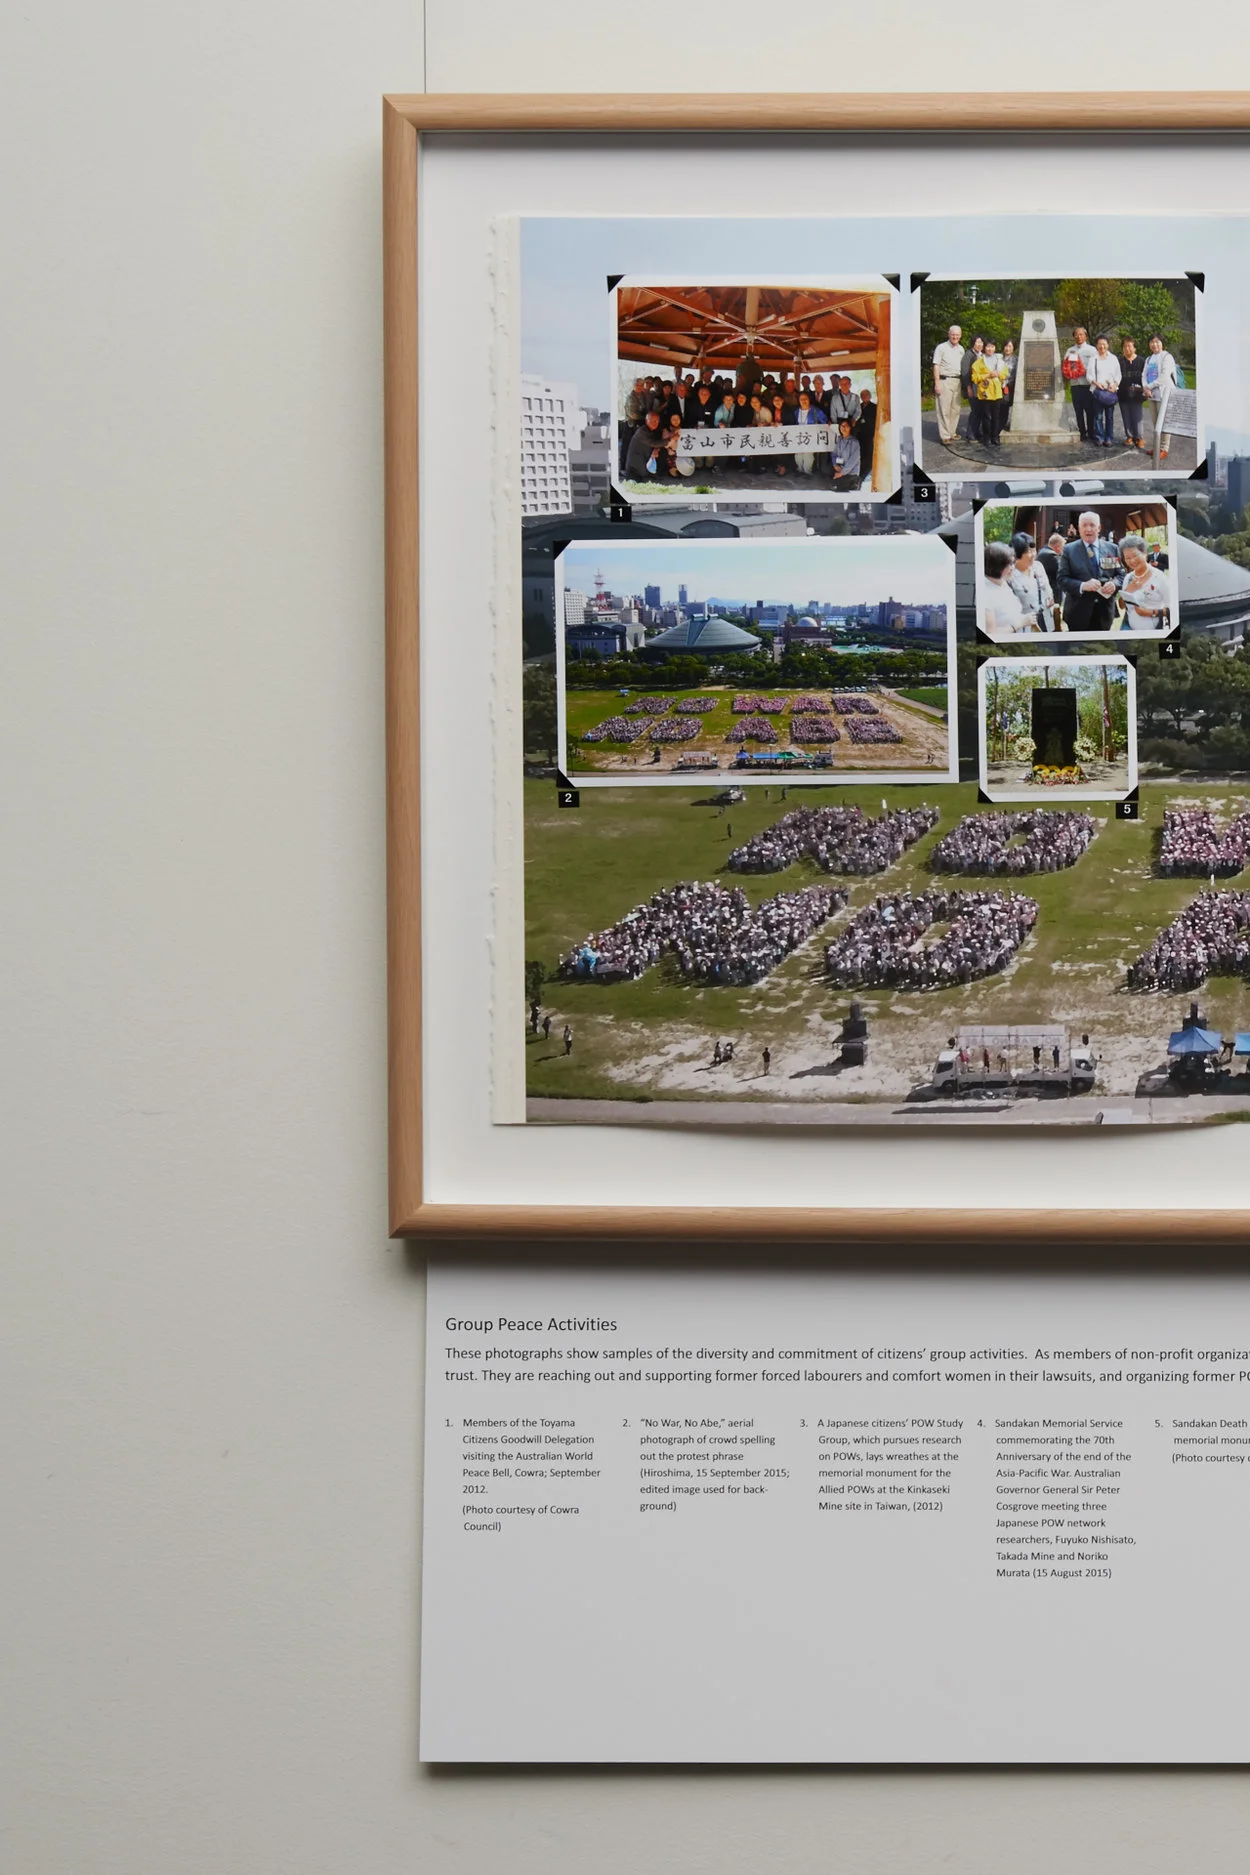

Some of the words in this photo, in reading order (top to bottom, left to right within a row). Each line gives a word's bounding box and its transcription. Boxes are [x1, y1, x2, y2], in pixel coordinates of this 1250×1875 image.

[921, 487, 929, 498] 3
[617, 507, 624, 517] 1
[1165, 643, 1174, 654] 4
[564, 792, 572, 803] 2
[1123, 804, 1131, 814] 5
[445, 1317, 494, 1334] Group
[498, 1317, 543, 1331] Peace
[546, 1317, 618, 1332] Activities
[444, 1346, 482, 1360] These
[485, 1346, 564, 1362] photographs
[566, 1347, 600, 1360] show
[602, 1347, 653, 1362] samples
[655, 1346, 670, 1360] of
[671, 1347, 693, 1360] the
[695, 1347, 749, 1362] diversity
[751, 1347, 775, 1360] and
[778, 1347, 858, 1360] commitment
[860, 1347, 875, 1360] of
[929, 1350, 967, 1363] group
[969, 1348, 1028, 1360] activities.
[1034, 1348, 1050, 1360] As
[1053, 1347, 1112, 1360] members
[1114, 1347, 1128, 1360] of
[1130, 1347, 1194, 1363] non-profit
[444, 1370, 478, 1381] trust.
[480, 1368, 512, 1384] They
[514, 1372, 535, 1382] are
[538, 1369, 591, 1384] reaching
[593, 1370, 616, 1382] out
[618, 1369, 642, 1382] and
[644, 1369, 713, 1384] supporting
[715, 1369, 759, 1382] former
[761, 1369, 801, 1382] forced
[803, 1369, 863, 1382] labourers
[865, 1369, 889, 1382] and
[892, 1369, 942, 1382] comfort
[944, 1372, 992, 1382] women
[994, 1370, 1006, 1382] in
[1009, 1369, 1040, 1382] their
[1042, 1369, 1096, 1384] lawsuits,
[1099, 1369, 1123, 1382] and
[1125, 1370, 1190, 1385] organizing
[1192, 1369, 1236, 1382] former
[445, 1418, 454, 1428] 1.
[462, 1417, 508, 1428] Members
[509, 1417, 521, 1428] of
[521, 1418, 538, 1428] the
[539, 1418, 576, 1430] Toyama
[622, 1418, 631, 1428] 2.
[660, 1418, 682, 1429] War,
[684, 1418, 699, 1428] No
[727, 1418, 754, 1428] aerial
[799, 1418, 809, 1428] 3.
[817, 1418, 825, 1428] A
[826, 1419, 870, 1430] Japanese
[911, 1418, 935, 1428] POW
[936, 1418, 964, 1430] Study
[976, 1418, 986, 1428] 4.
[994, 1418, 1040, 1428] Sandakan
[1042, 1418, 1088, 1428] Memorial
[1089, 1418, 1124, 1428] Service
[1154, 1419, 1164, 1428] 5.
[1172, 1418, 1218, 1428] Sandakan
[1219, 1418, 1248, 1429] Death
[462, 1484, 489, 1495] 2012.
[639, 1501, 677, 1513] ground)
[818, 1501, 843, 1511] Mine
[844, 1501, 862, 1511] site
[863, 1501, 873, 1511] in
[875, 1501, 911, 1512] Taiwan,
[912, 1501, 944, 1513] (2012)
[996, 1568, 1031, 1578] Murata
[1032, 1567, 1048, 1579] (15
[1050, 1568, 1083, 1580] August
[1085, 1568, 1112, 1580] 2015)
